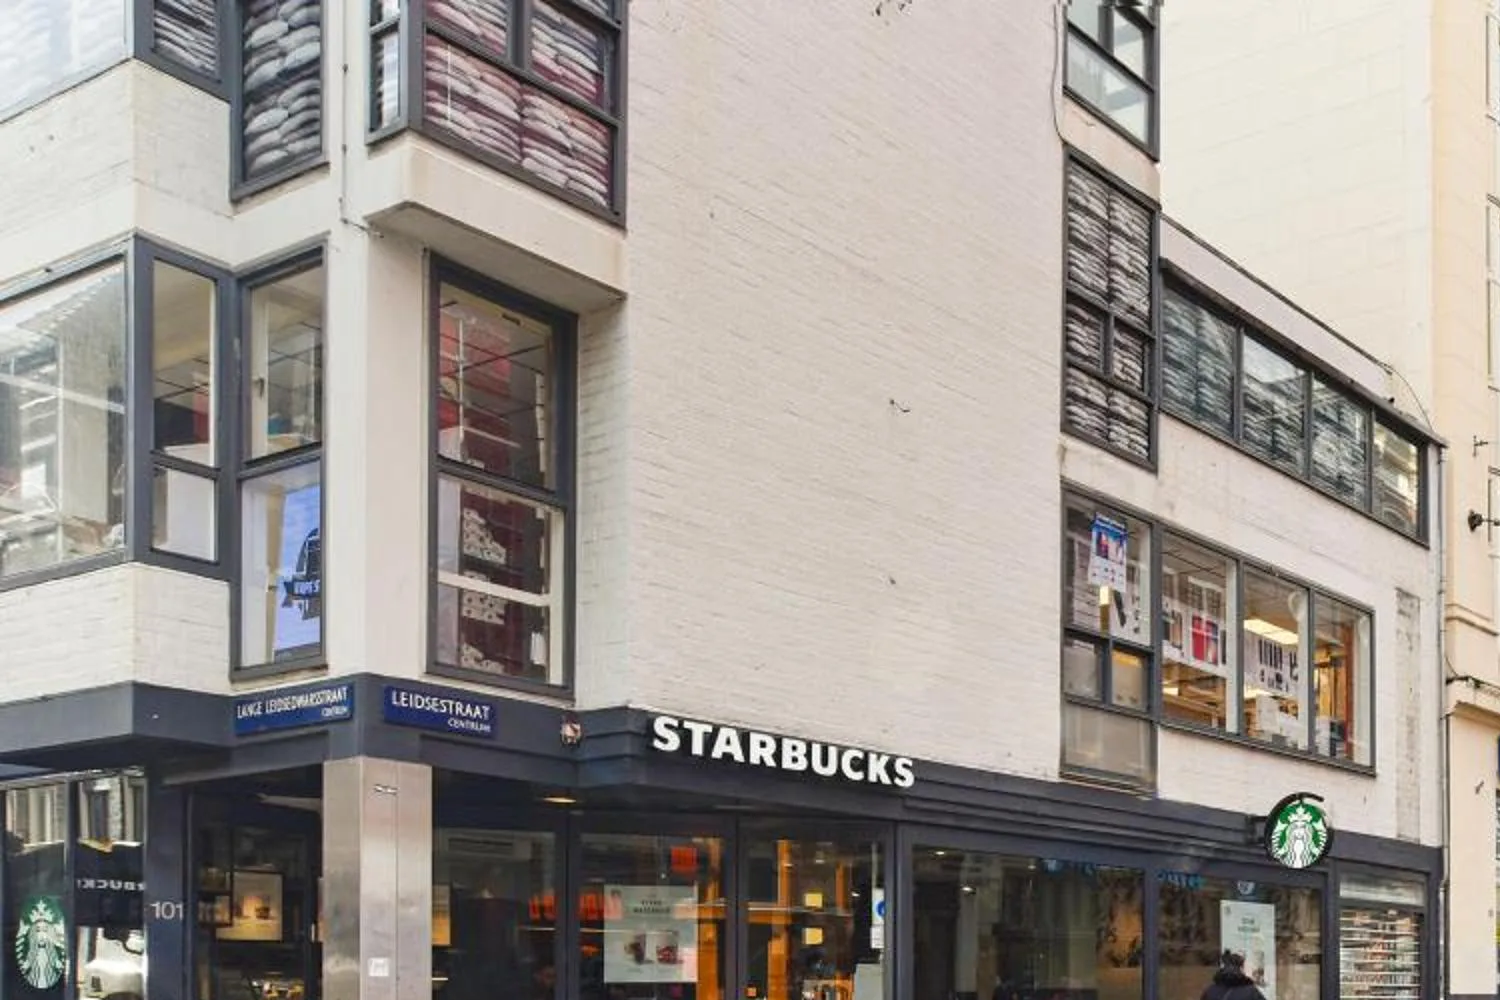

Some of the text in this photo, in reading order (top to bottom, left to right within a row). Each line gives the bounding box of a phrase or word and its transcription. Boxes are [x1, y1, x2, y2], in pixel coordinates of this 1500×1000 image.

[236, 700, 262, 719] LANGE
[391, 690, 491, 720] LEIDSESTRAAT
[447, 717, 492, 733] CENTRUM
[652, 715, 916, 788] STARBUCKS
[150, 901, 184, 920] 101
